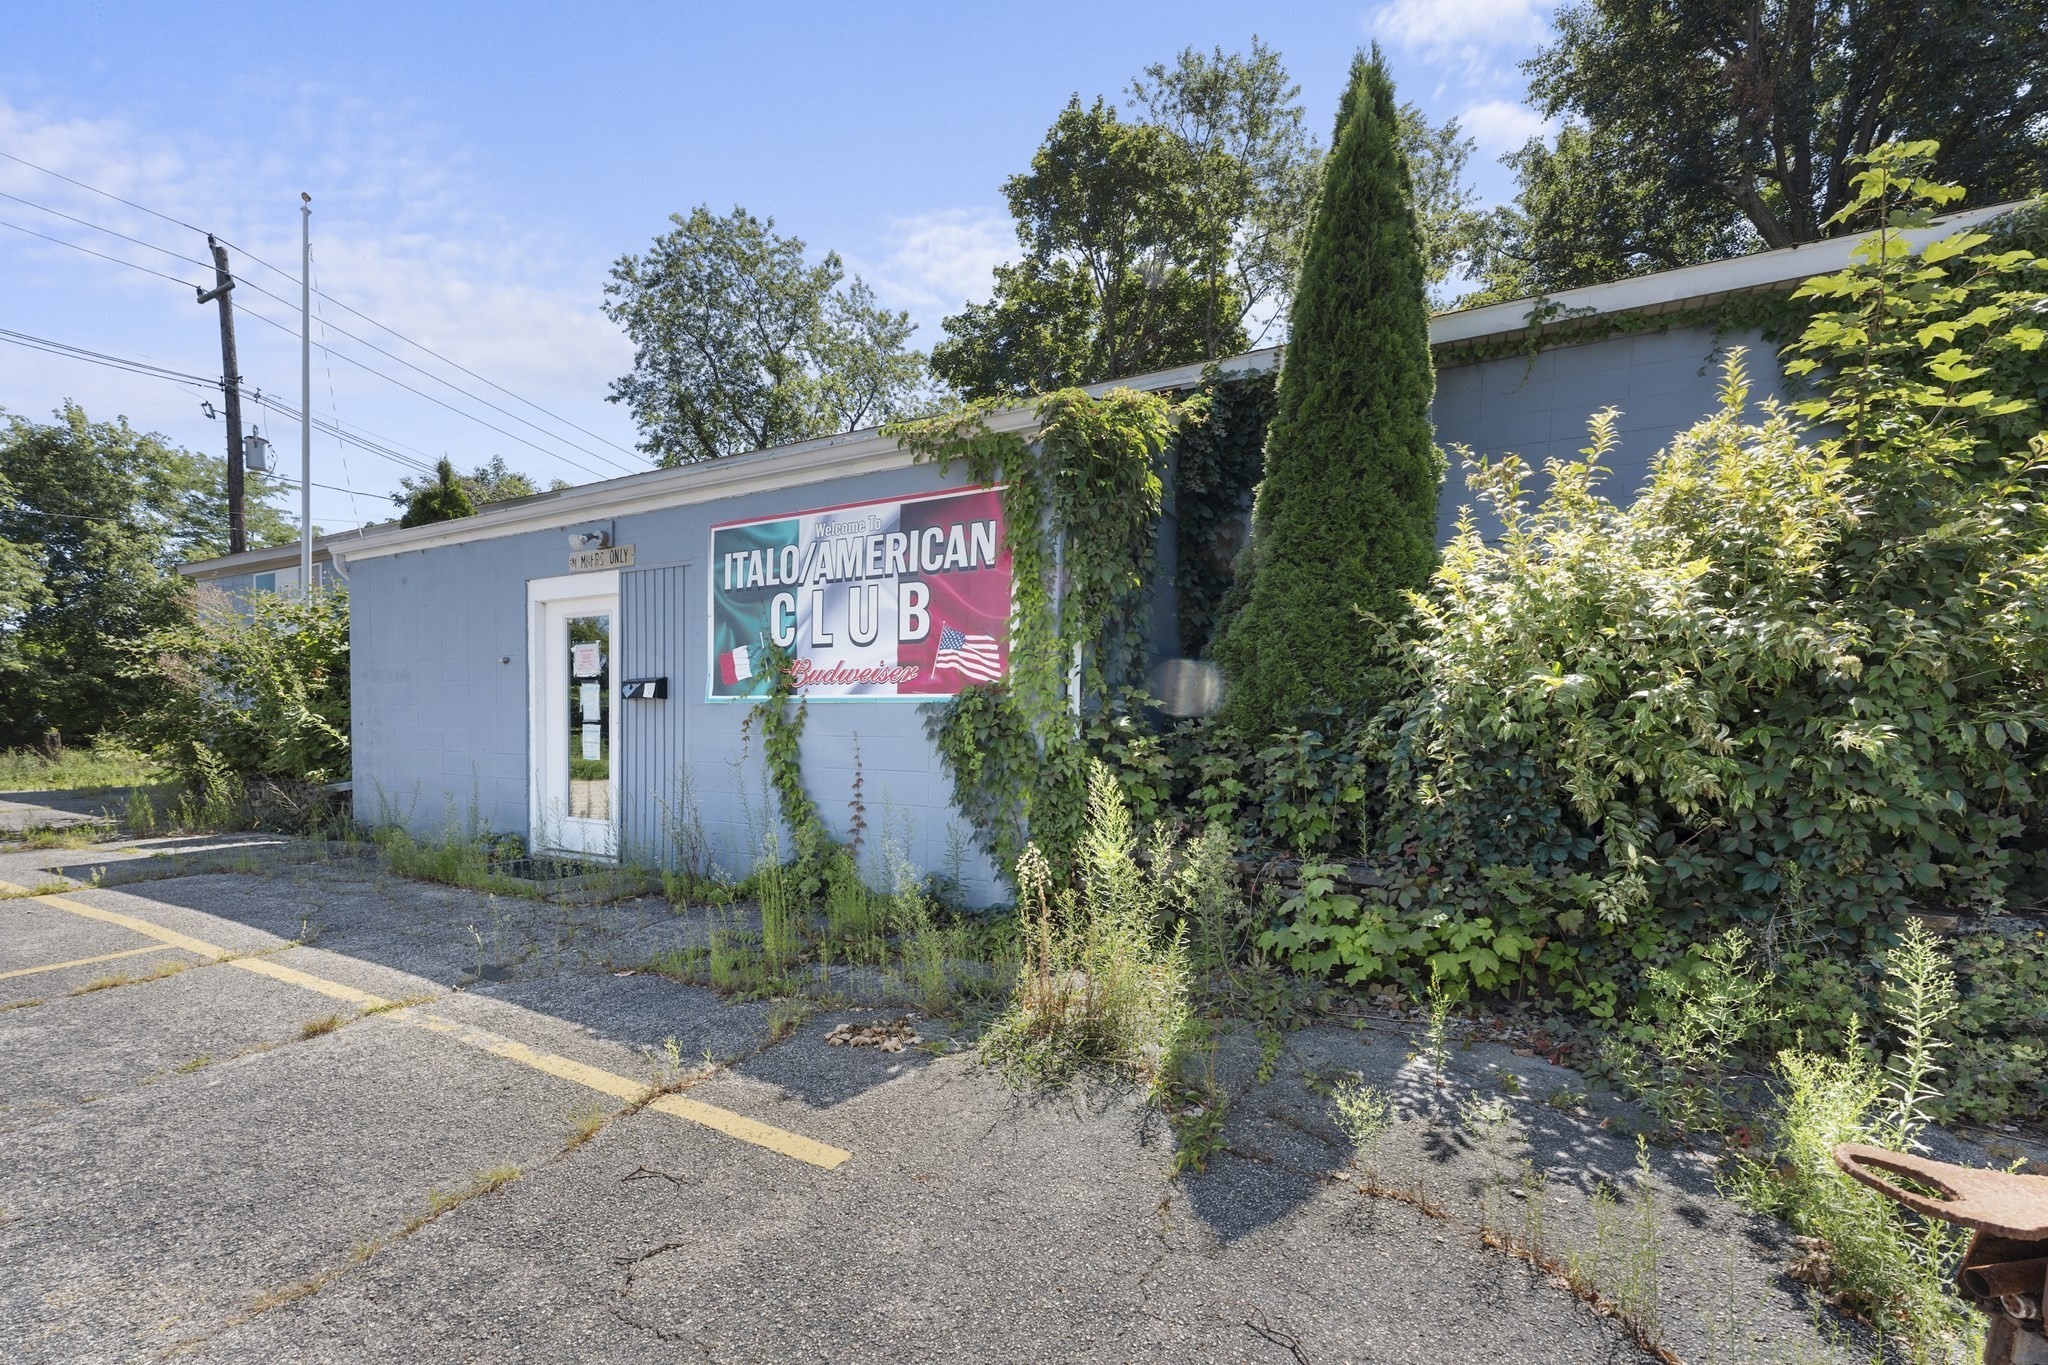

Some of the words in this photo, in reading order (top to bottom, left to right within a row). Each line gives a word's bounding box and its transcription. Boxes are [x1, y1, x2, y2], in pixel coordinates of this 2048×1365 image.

[815, 517, 866, 539] Welcome
[868, 515, 882, 532] To
[571, 551, 603, 569] MMBERS
[609, 548, 629, 565] ONLY
[724, 520, 997, 593] ITALO/AMERICAN
[770, 581, 931, 648] CLUB
[790, 658, 919, 688] Budweiser
